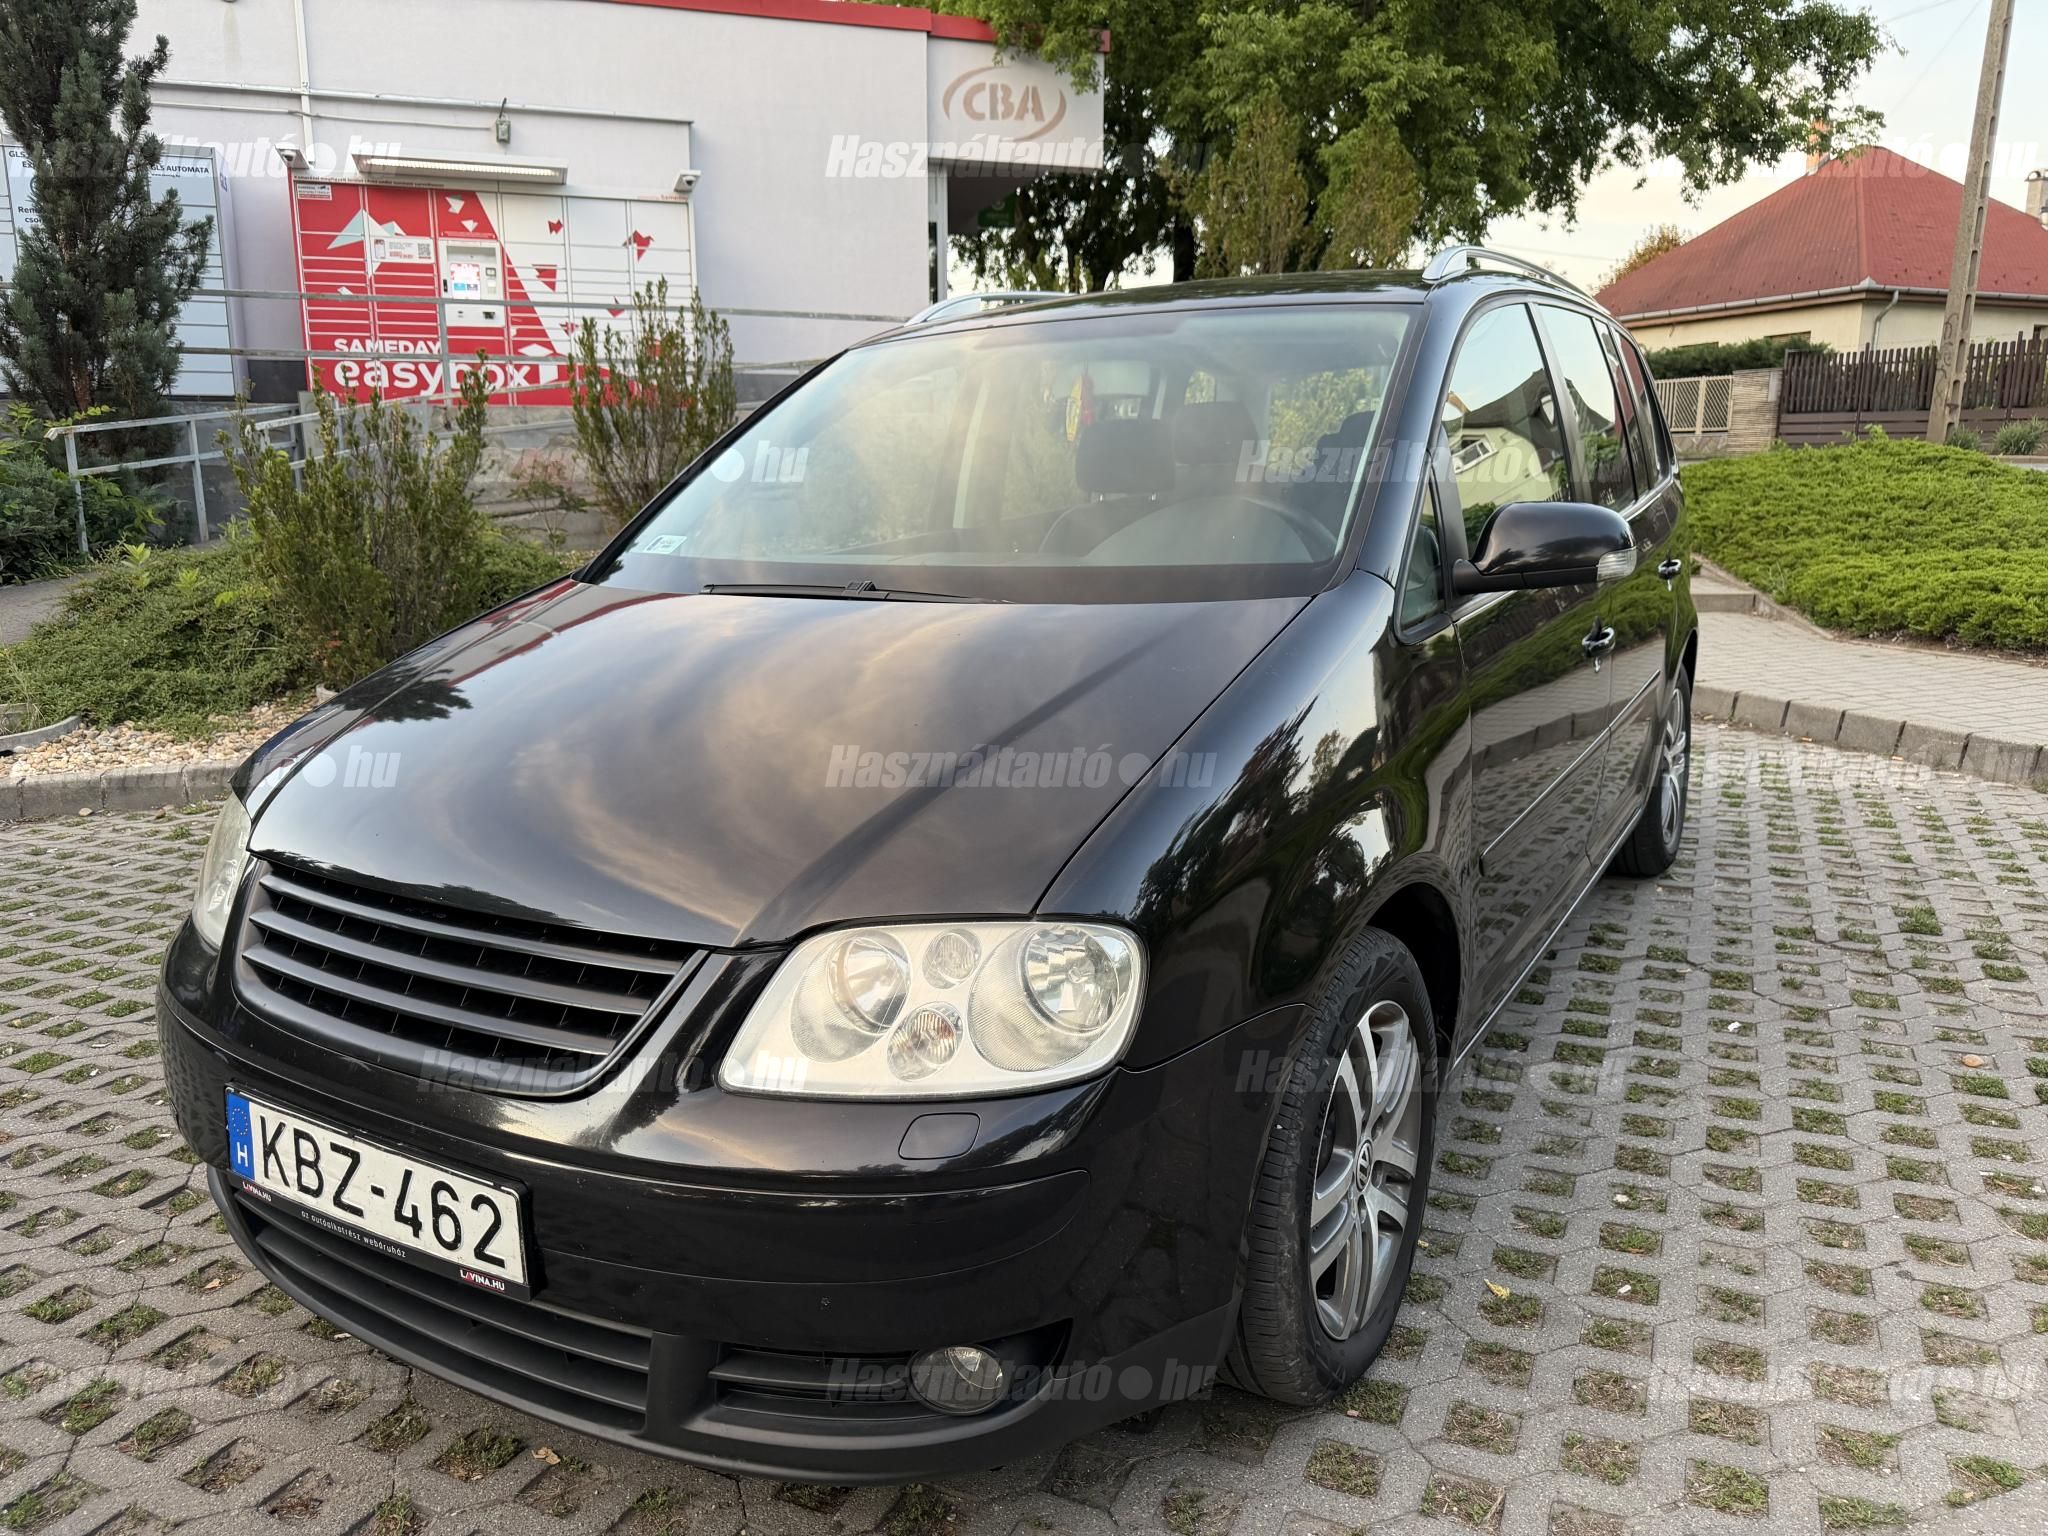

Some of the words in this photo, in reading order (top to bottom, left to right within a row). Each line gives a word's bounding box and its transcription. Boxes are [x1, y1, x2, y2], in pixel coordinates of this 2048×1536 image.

[962, 81, 1046, 123] CBA
[166, 165, 210, 174] AUTOMATA
[334, 337, 441, 354] SAMEDAY
[237, 1141, 249, 1168] H
[259, 1115, 506, 1270] KBZ-462
[364, 1236, 406, 1258] webáruház
